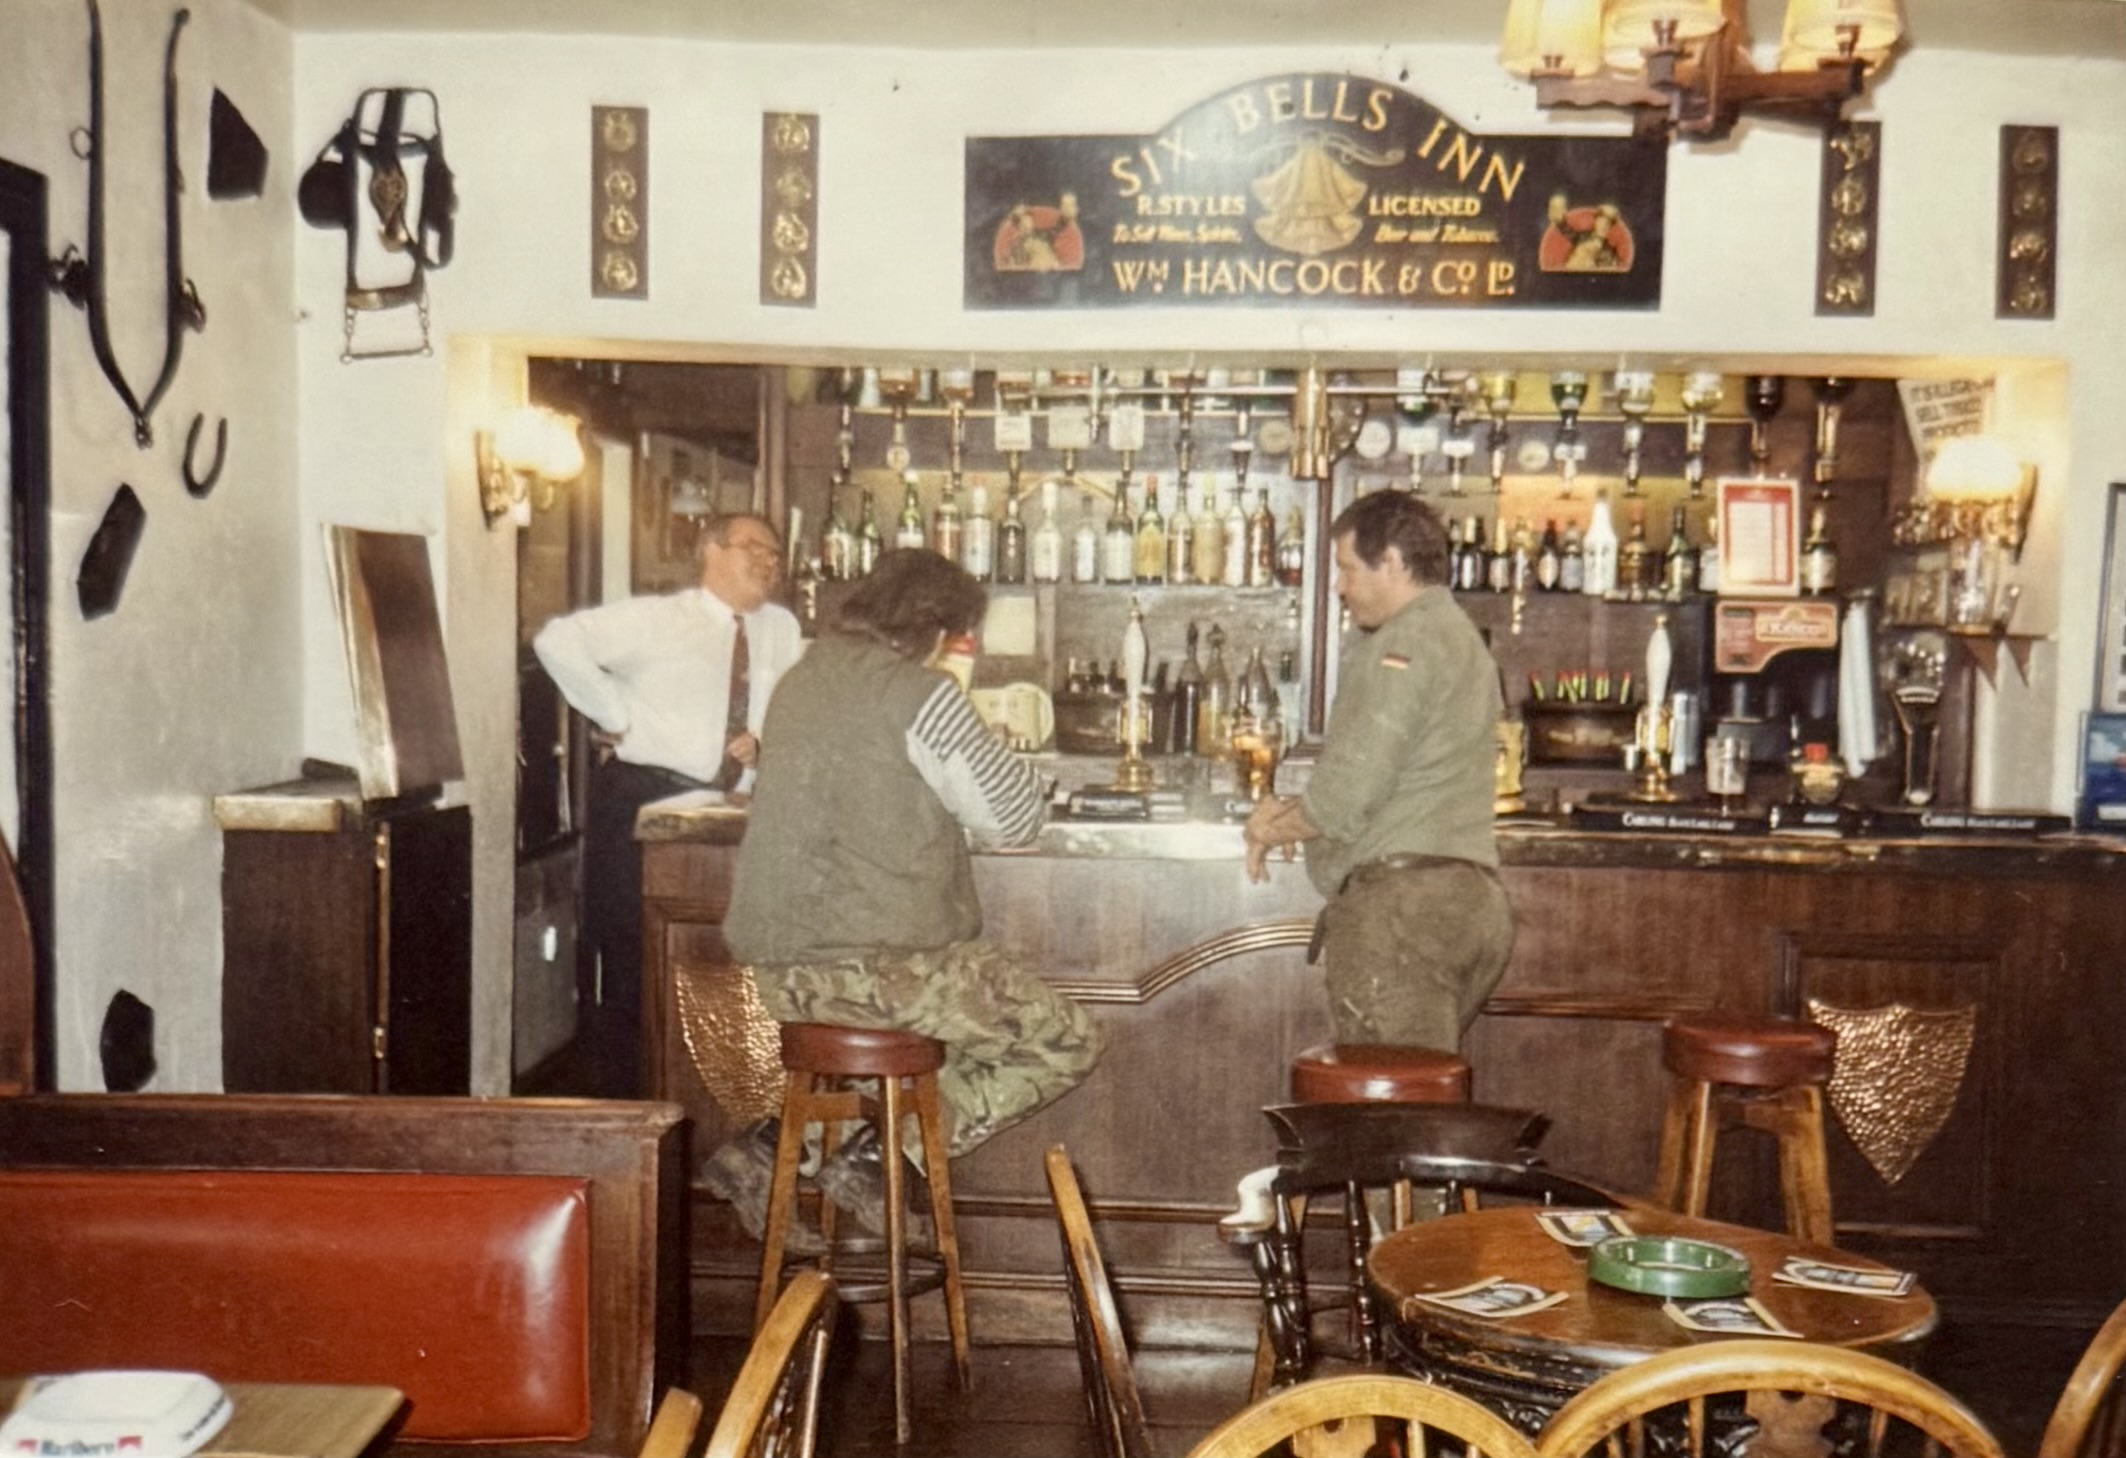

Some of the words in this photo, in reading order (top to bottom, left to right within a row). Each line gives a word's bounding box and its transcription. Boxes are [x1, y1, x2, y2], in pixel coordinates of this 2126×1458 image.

[1111, 127, 1196, 197] SIX
[1227, 79, 1393, 133] BELLS
[1417, 119, 1524, 202] INN
[1369, 195, 1481, 216] LICENSED
[1183, 258, 1386, 295] HANCOCK
[1397, 263, 1422, 295] &
